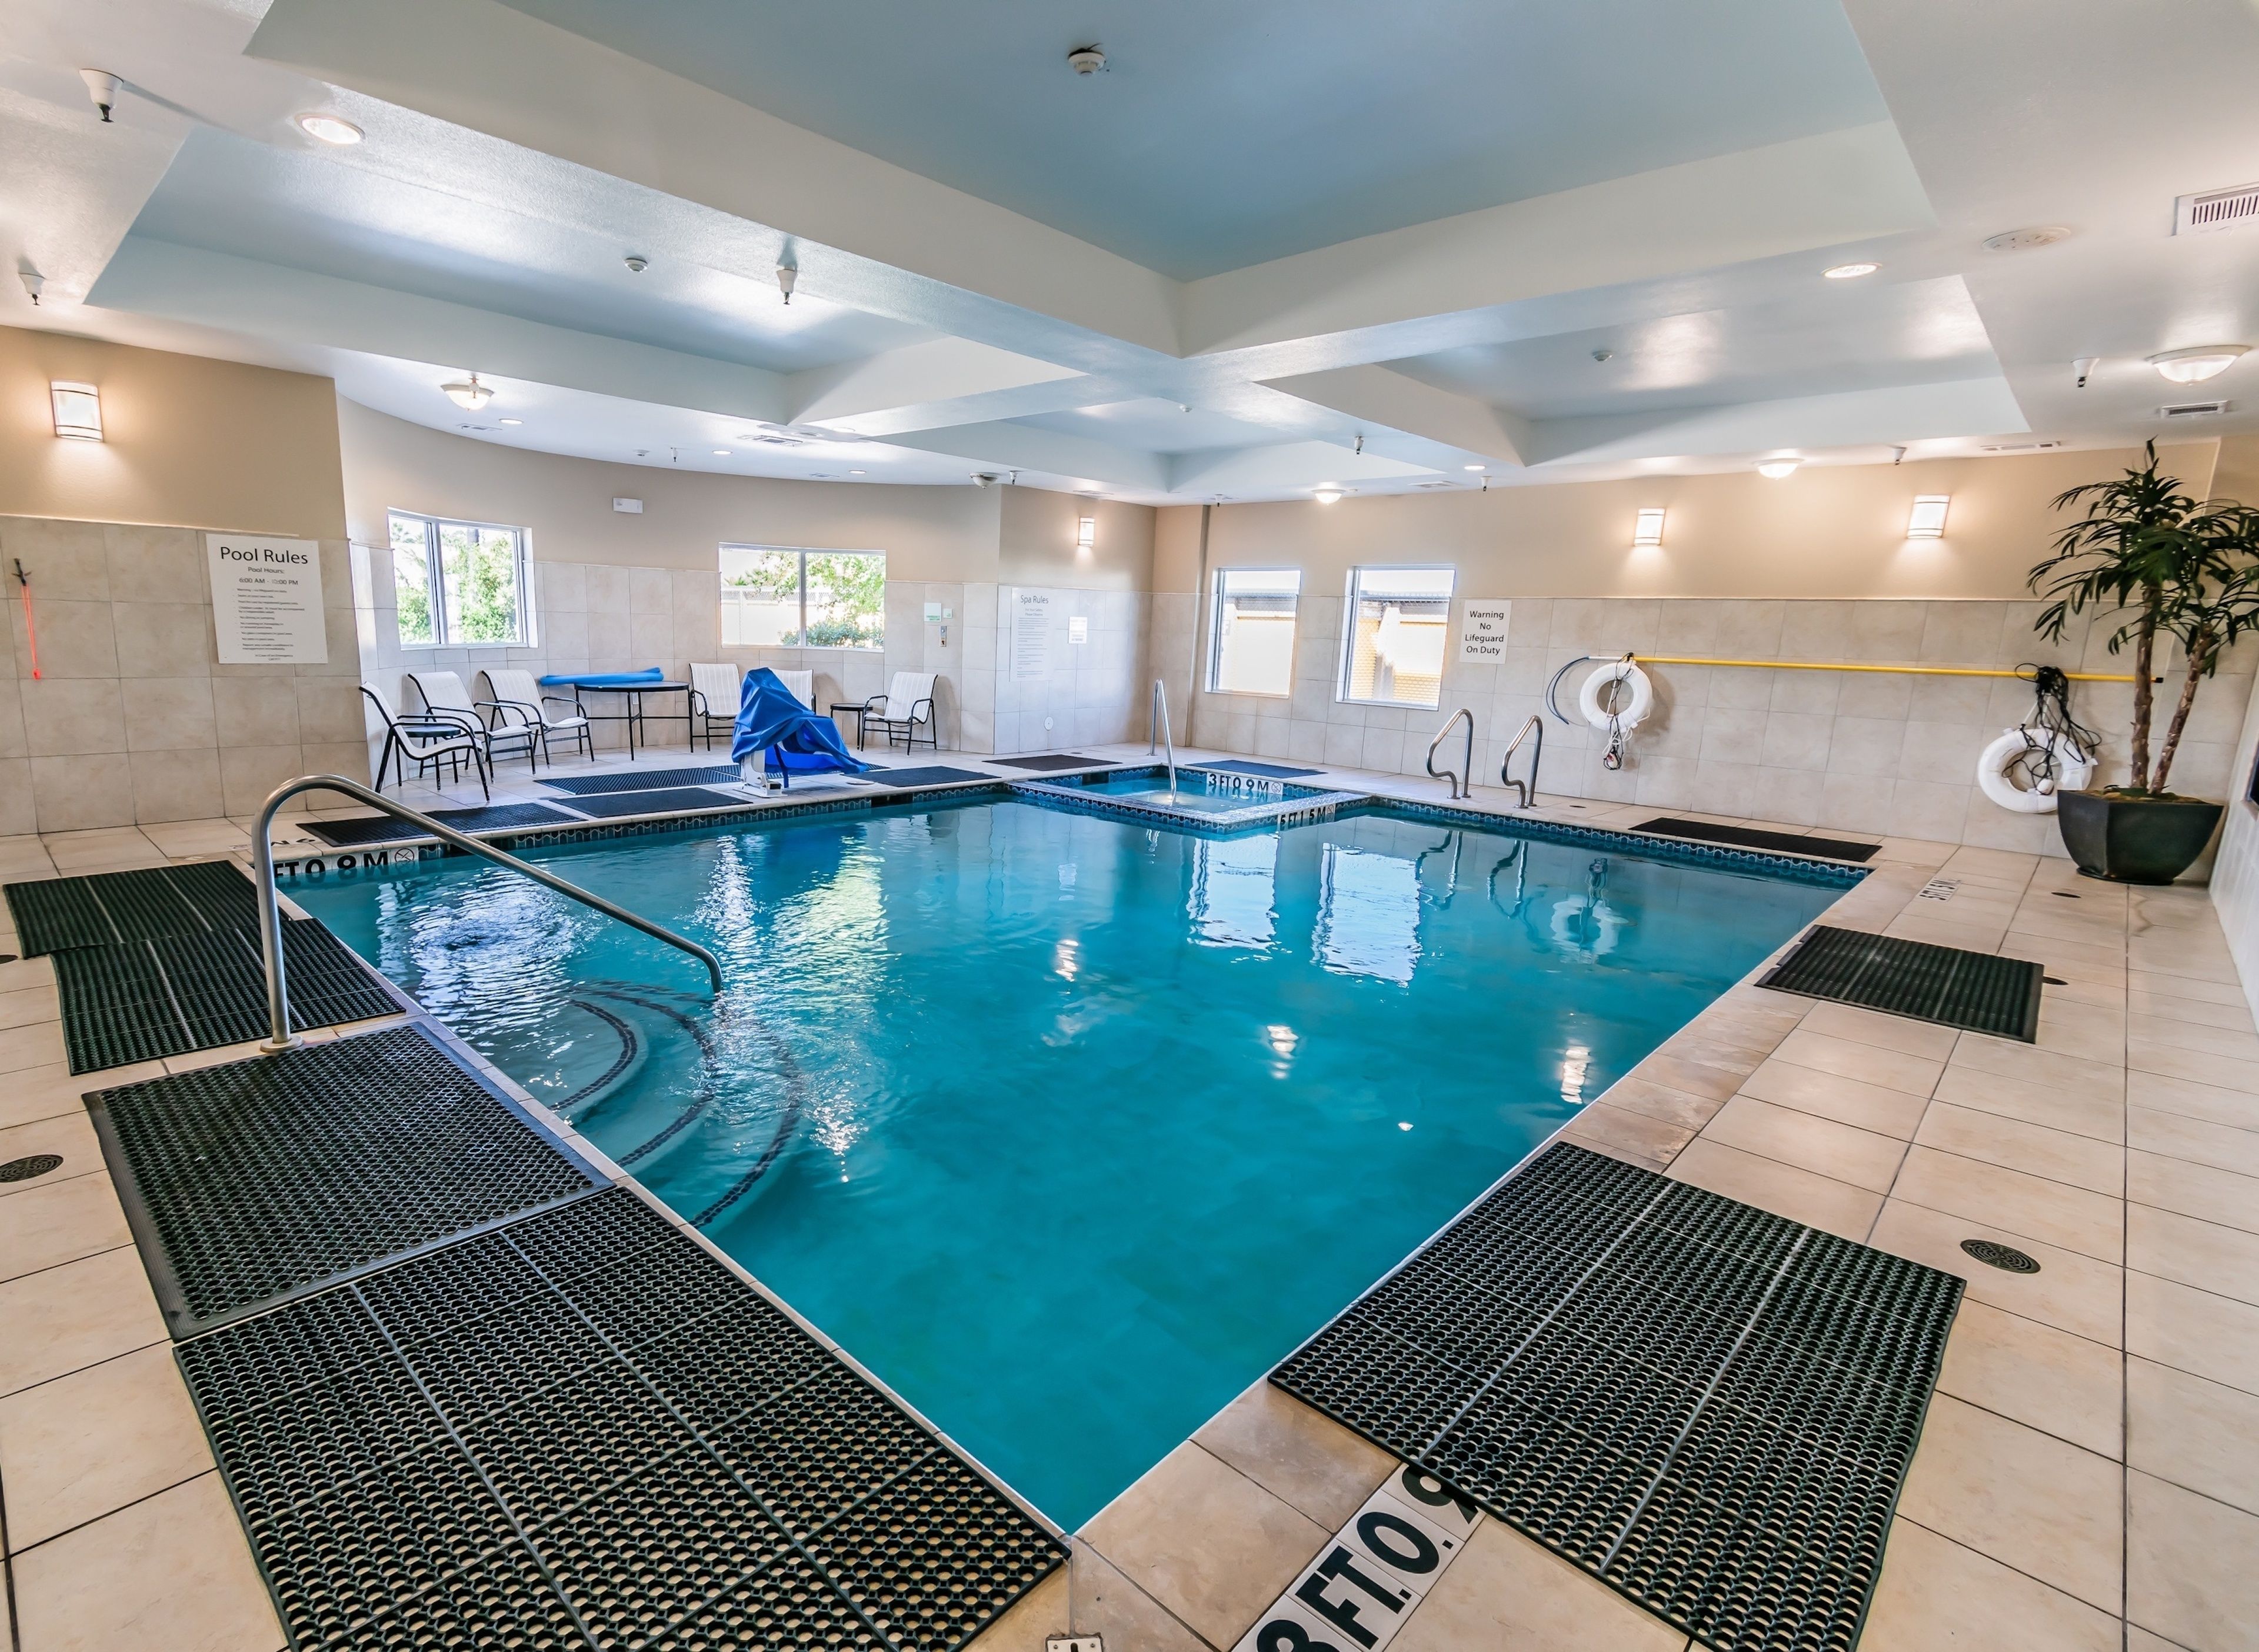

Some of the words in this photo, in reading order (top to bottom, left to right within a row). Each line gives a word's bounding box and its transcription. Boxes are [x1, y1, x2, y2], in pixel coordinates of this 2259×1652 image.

[221, 547, 258, 561] Pool
[264, 549, 308, 564] Rules
[1021, 595, 1031, 604] Spa
[1032, 595, 1049, 604] Rules
[1470, 611, 1504, 620] Warning
[1465, 634, 1504, 643] Lifeguard
[1480, 646, 1501, 655] Duty
